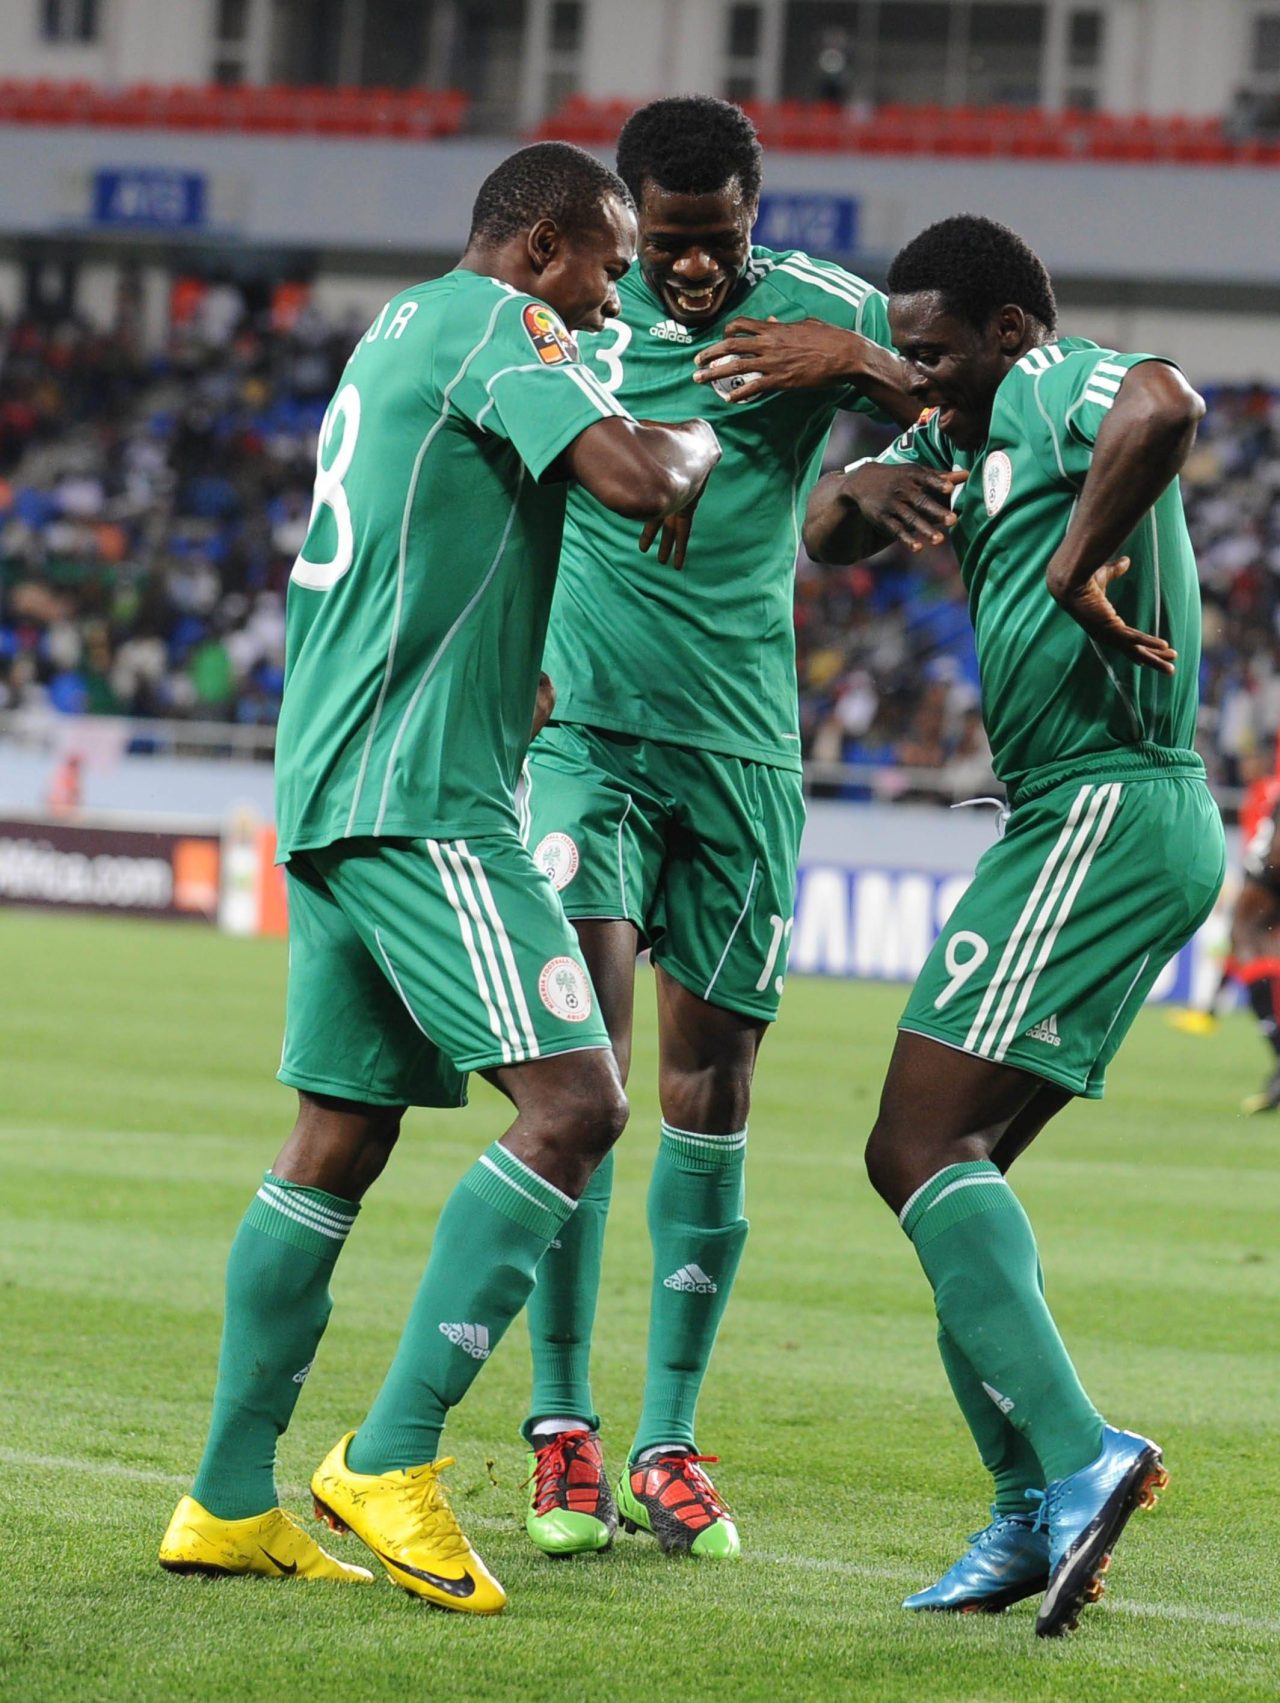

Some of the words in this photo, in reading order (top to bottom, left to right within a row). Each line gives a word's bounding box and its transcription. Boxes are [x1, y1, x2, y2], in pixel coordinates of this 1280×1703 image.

[649, 326, 693, 344] adidas
[291, 384, 361, 591] 8
[934, 930, 989, 1009] 9
[1025, 1029, 1061, 1047] adidas
[663, 1278, 718, 1294] adidas
[438, 1322, 490, 1360] adidas
